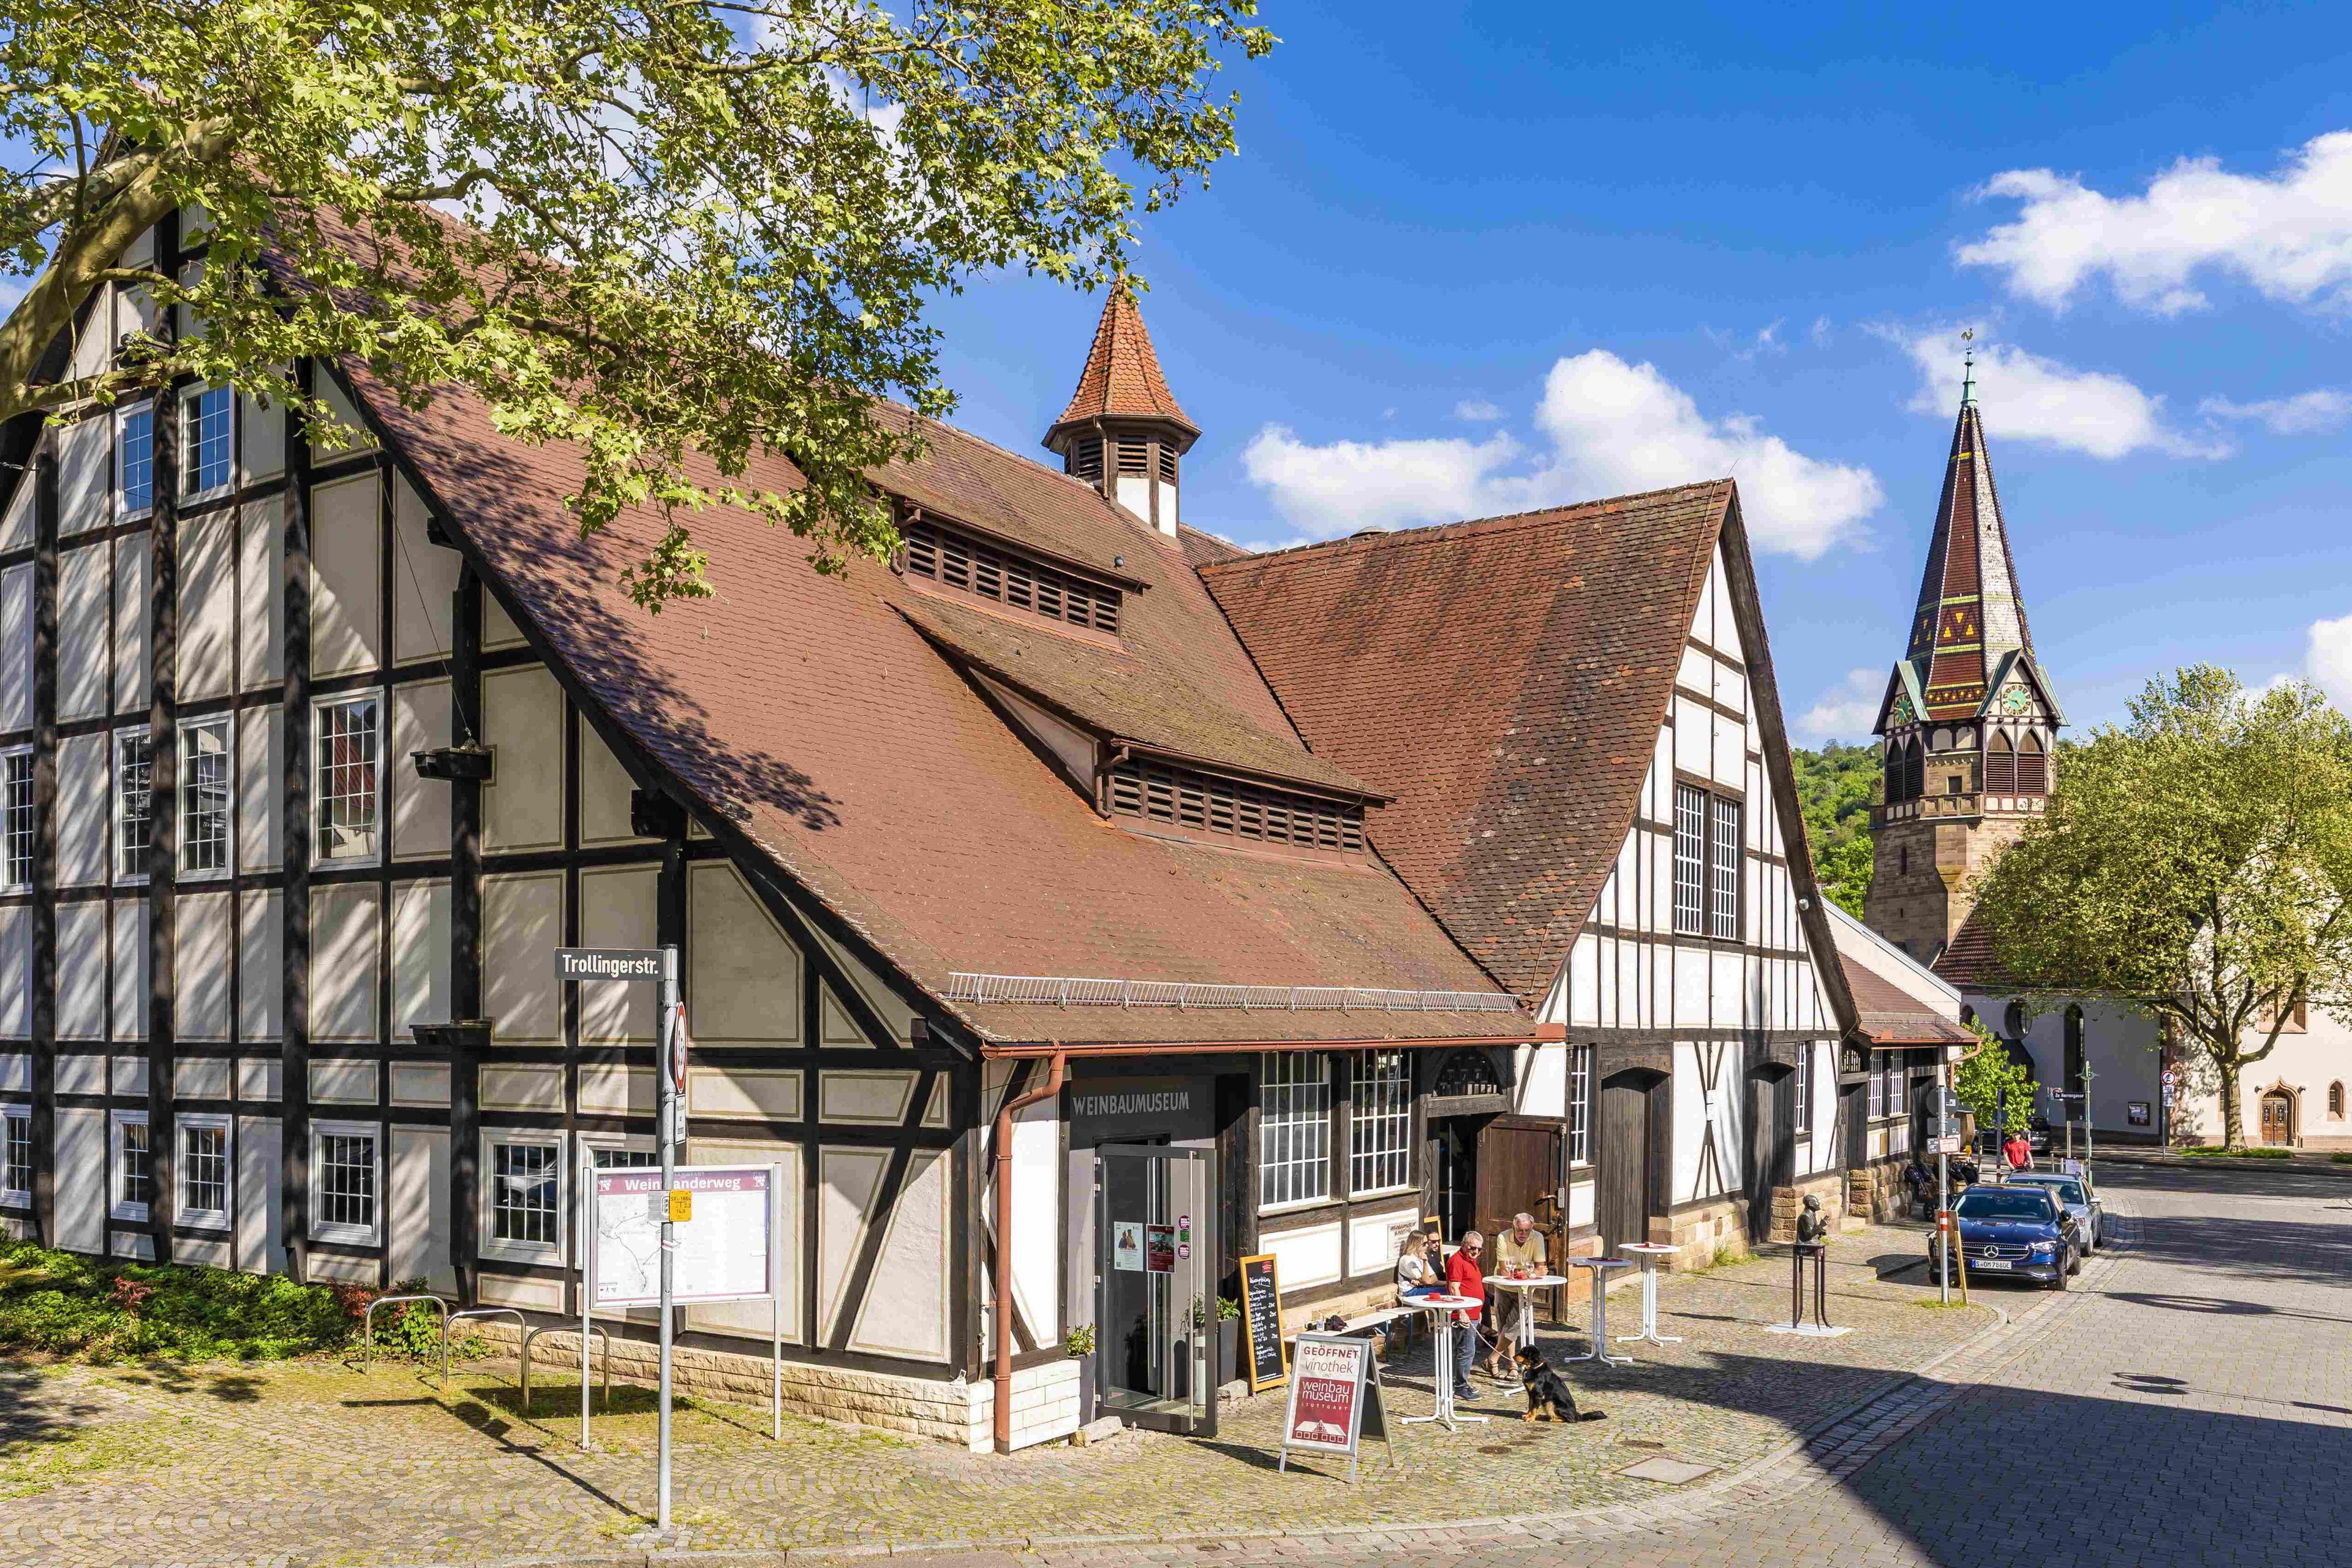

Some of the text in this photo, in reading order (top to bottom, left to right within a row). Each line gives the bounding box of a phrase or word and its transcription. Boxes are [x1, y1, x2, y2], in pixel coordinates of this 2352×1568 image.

[562, 954, 658, 978] Trollingerstr.
[1072, 1091, 1189, 1116] WEINBAUMUSEUM
[625, 1177, 741, 1191] Weinanderweg
[1304, 1345, 1359, 1359] GEÖFFNET
[1305, 1359, 1354, 1374] vinothek
[1302, 1379, 1349, 1394] weinbau
[1302, 1390, 1349, 1403] museum
[1301, 1402, 1348, 1411] STUTTGART
